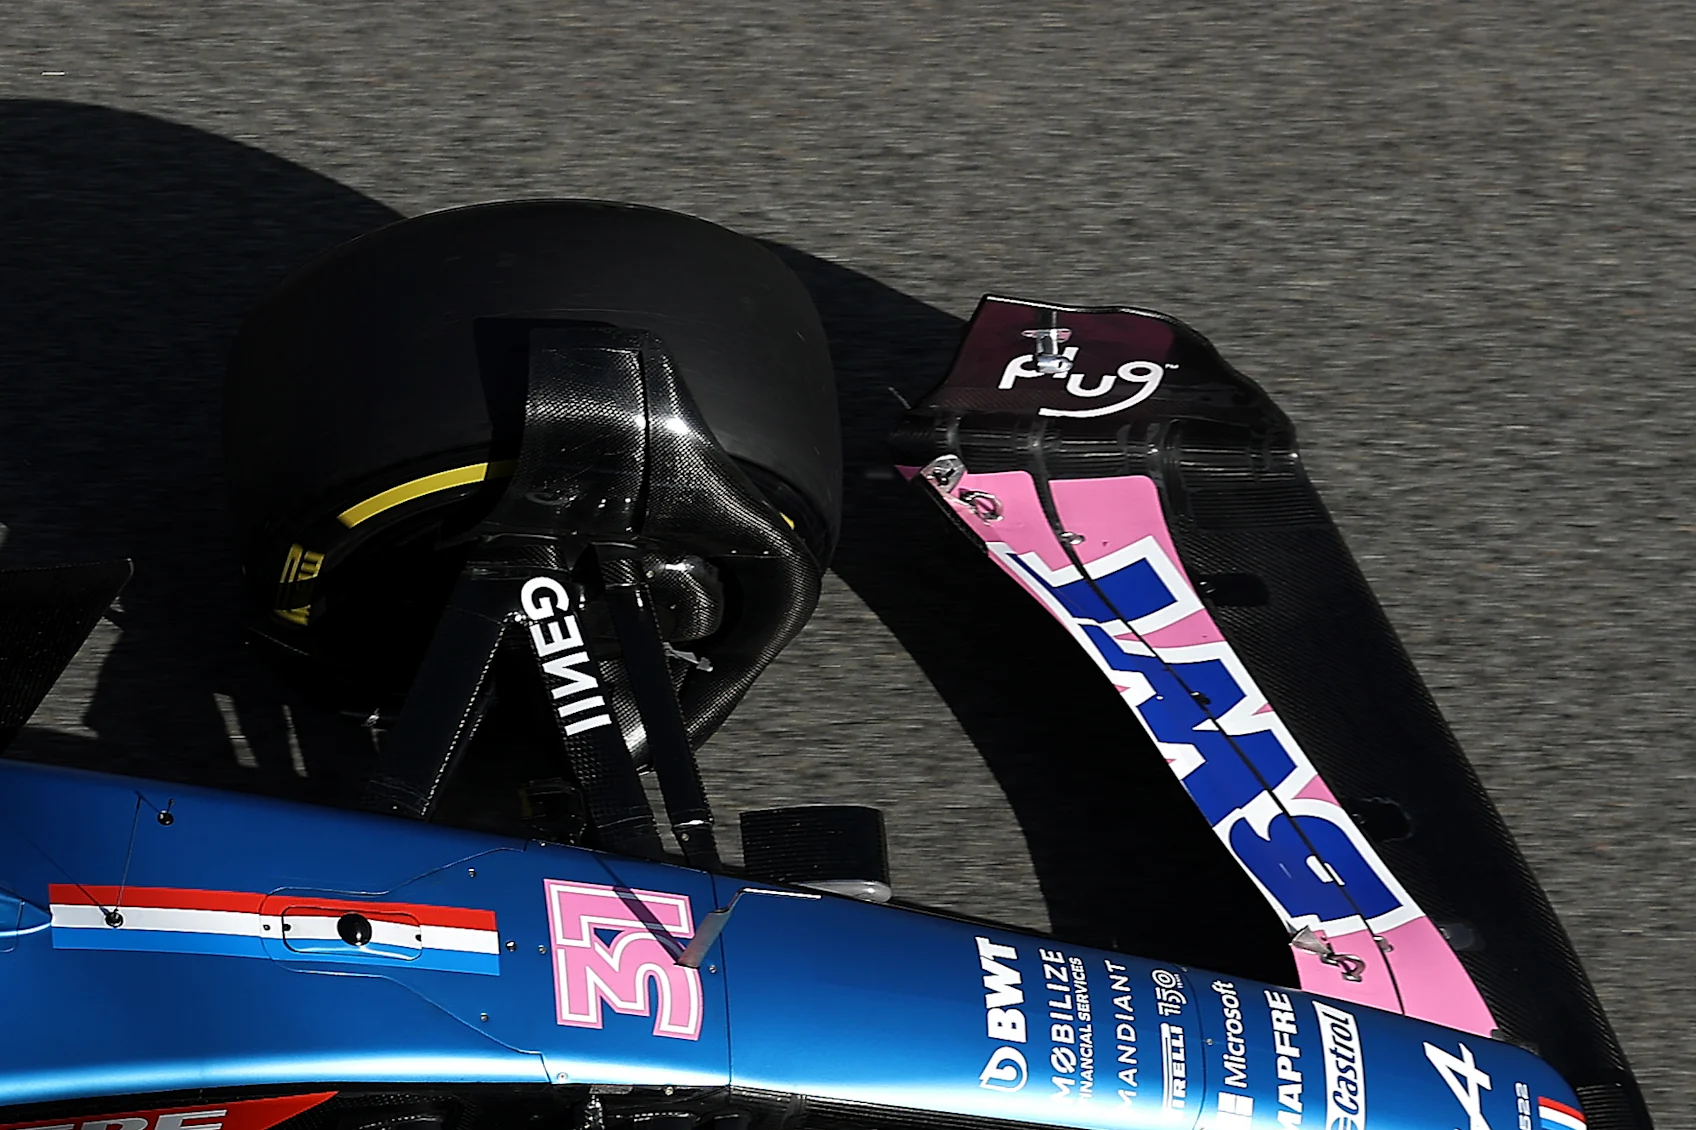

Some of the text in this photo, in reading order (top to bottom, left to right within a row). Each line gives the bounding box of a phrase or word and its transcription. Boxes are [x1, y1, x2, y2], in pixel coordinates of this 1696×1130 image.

[999, 548, 1411, 926] BWT
[542, 878, 704, 1041] 31
[976, 937, 1028, 1043] BWT
[1069, 957, 1094, 1103] INANCIAL SERVICES
[1105, 960, 1138, 1112] MANDIANT
[1211, 980, 1247, 1088] Microsoft
[1323, 1011, 1359, 1116] Castrol
